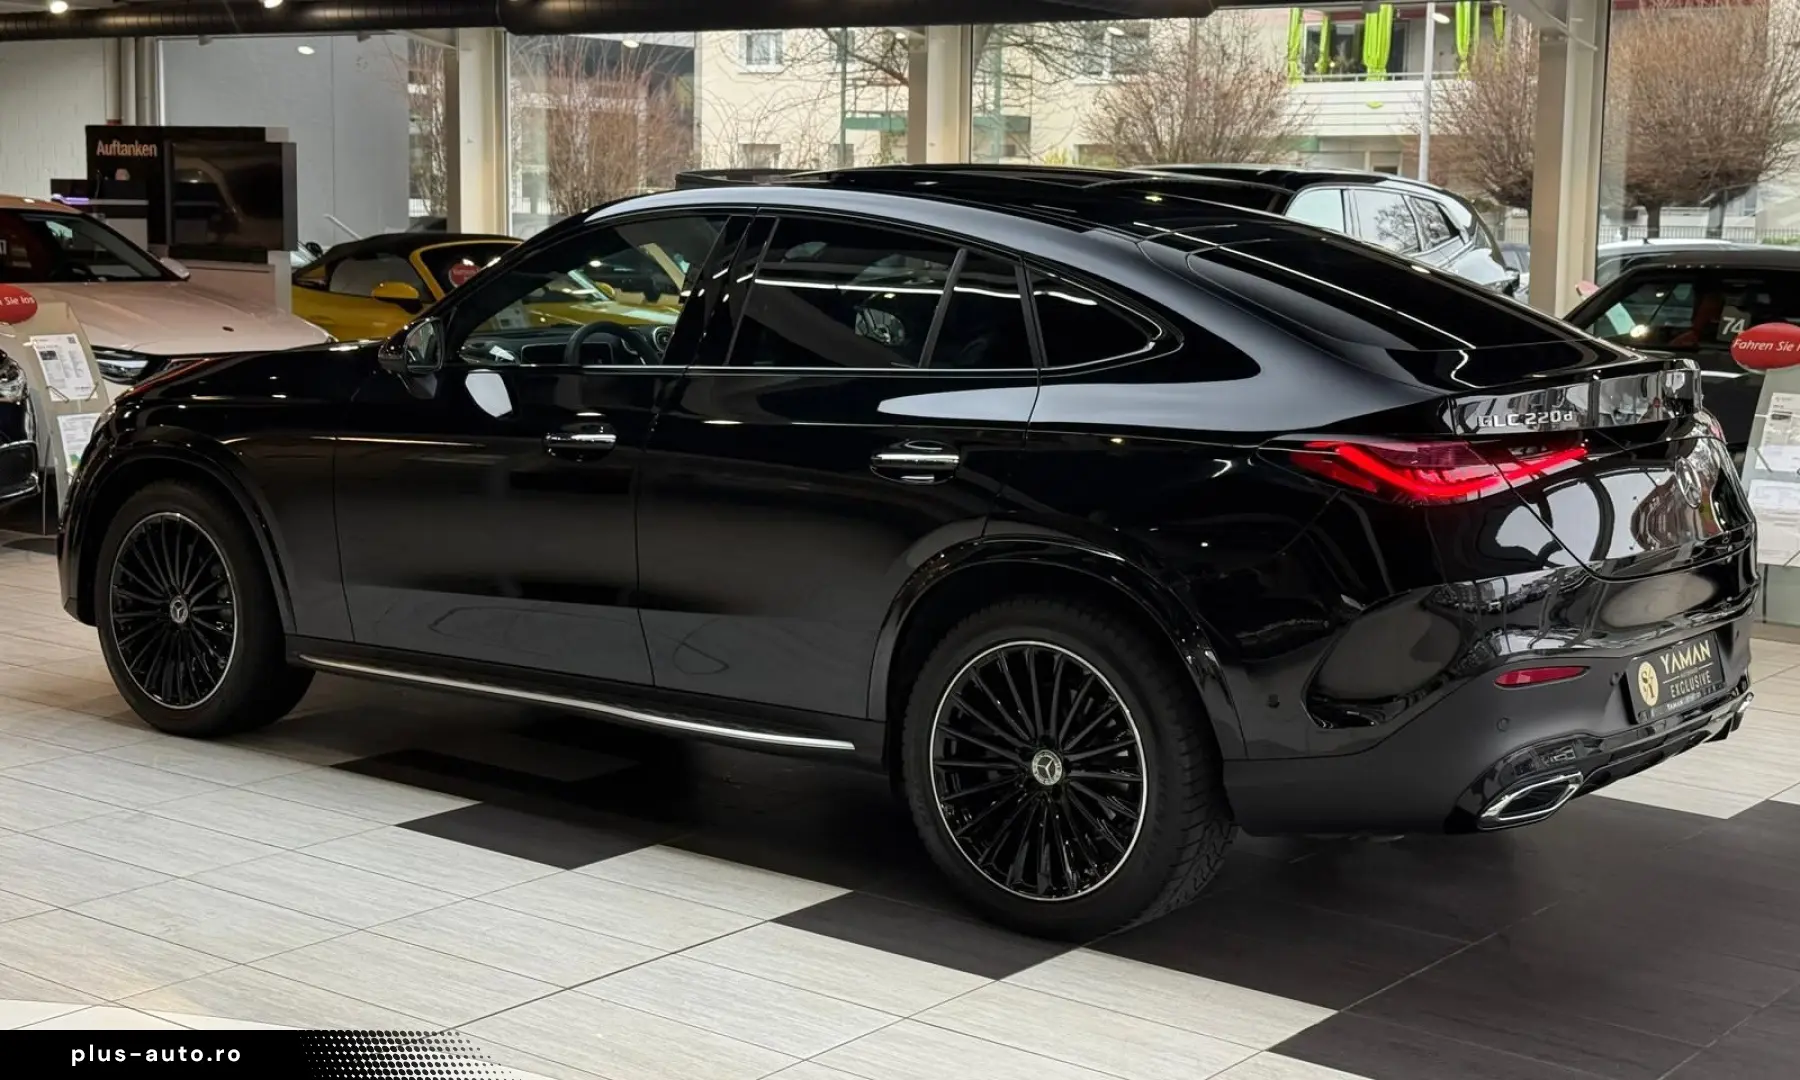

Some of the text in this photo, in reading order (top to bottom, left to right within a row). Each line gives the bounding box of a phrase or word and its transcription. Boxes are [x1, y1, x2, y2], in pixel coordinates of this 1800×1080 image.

[96, 139, 158, 157] Auftanken
[1722, 316, 1746, 335] 74
[1733, 338, 1774, 351] Fahren
[1776, 340, 1795, 352] Sie
[1478, 413, 1520, 427] GLC
[1660, 639, 1712, 675] YAMAN
[1669, 670, 1712, 699] EXCLUSIVE
